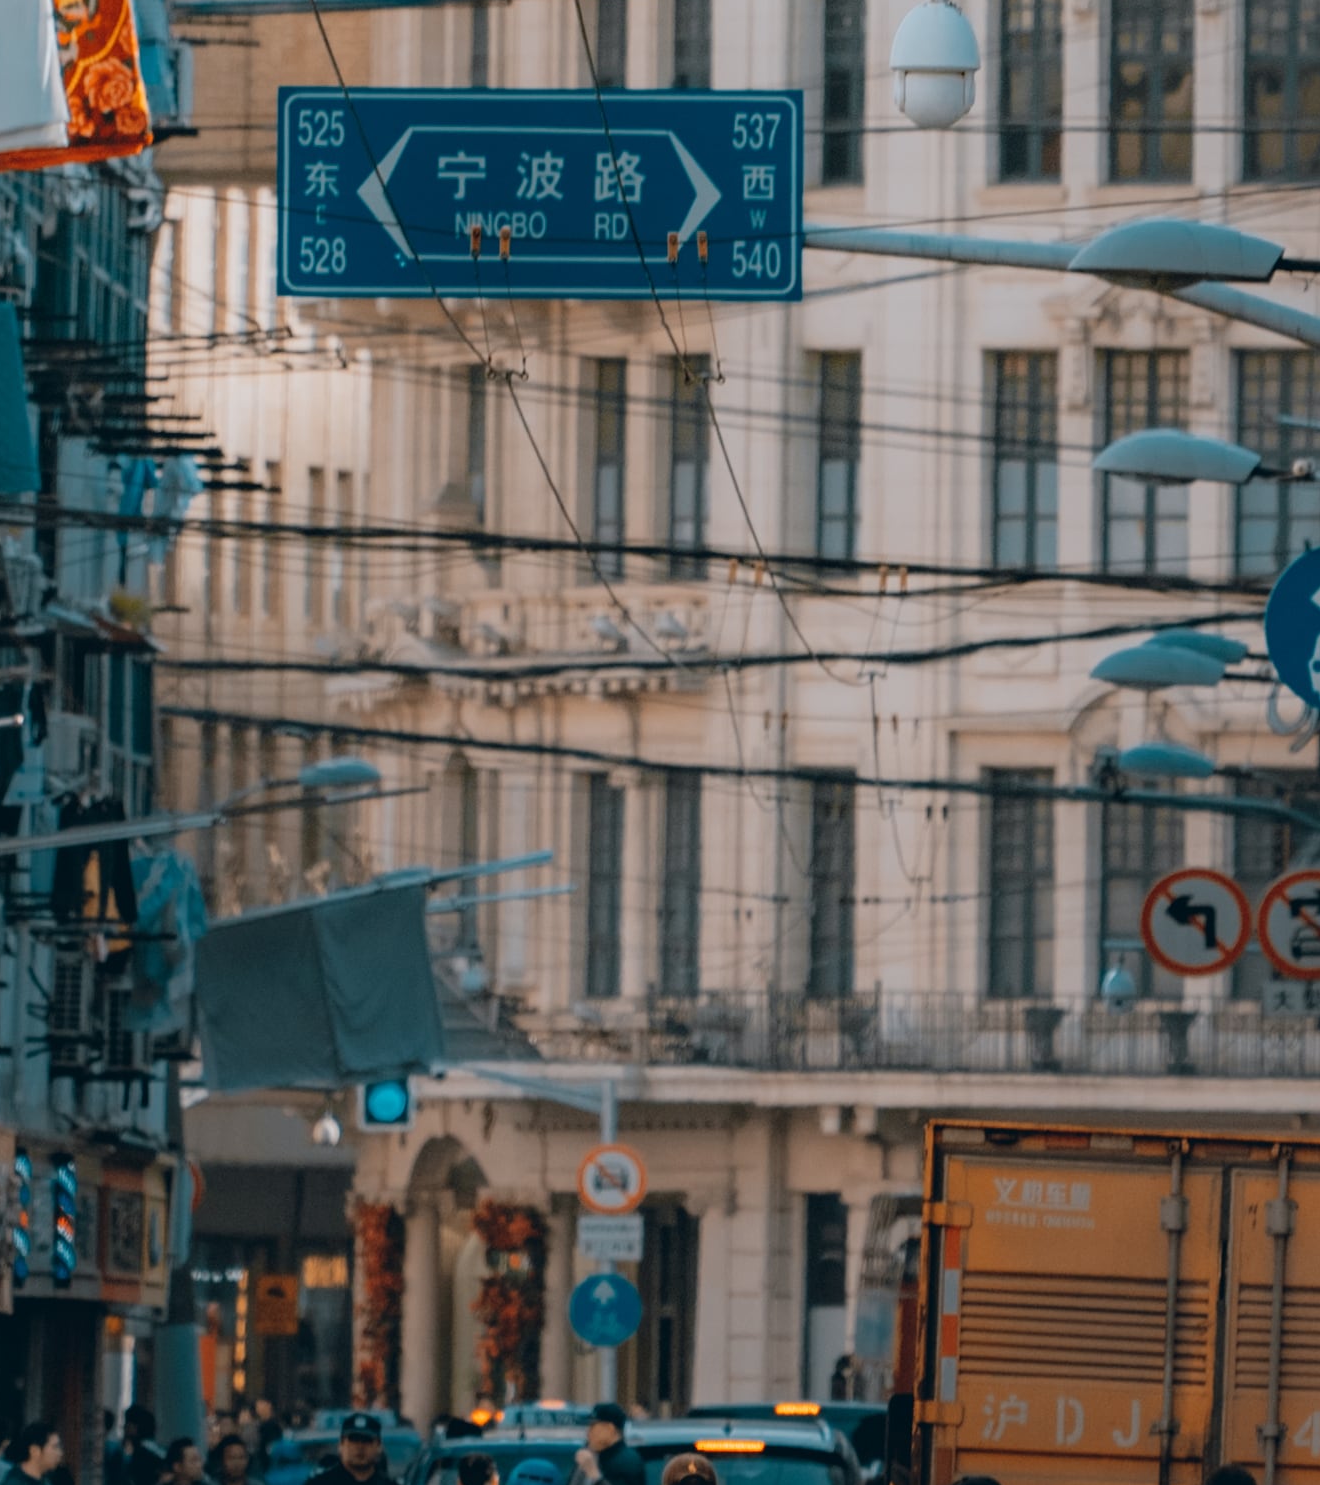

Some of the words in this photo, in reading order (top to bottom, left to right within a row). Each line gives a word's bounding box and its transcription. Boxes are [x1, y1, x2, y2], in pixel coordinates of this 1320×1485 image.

[298, 109, 345, 147] 525
[732, 113, 781, 150] 537
[305, 161, 339, 198] 东
[437, 150, 647, 204] 宁波路
[742, 164, 776, 202] 西
[454, 211, 547, 239] NINGBO
[594, 213, 629, 241] RD
[750, 208, 768, 230] W
[299, 236, 347, 274] 528
[731, 241, 781, 279] 540
